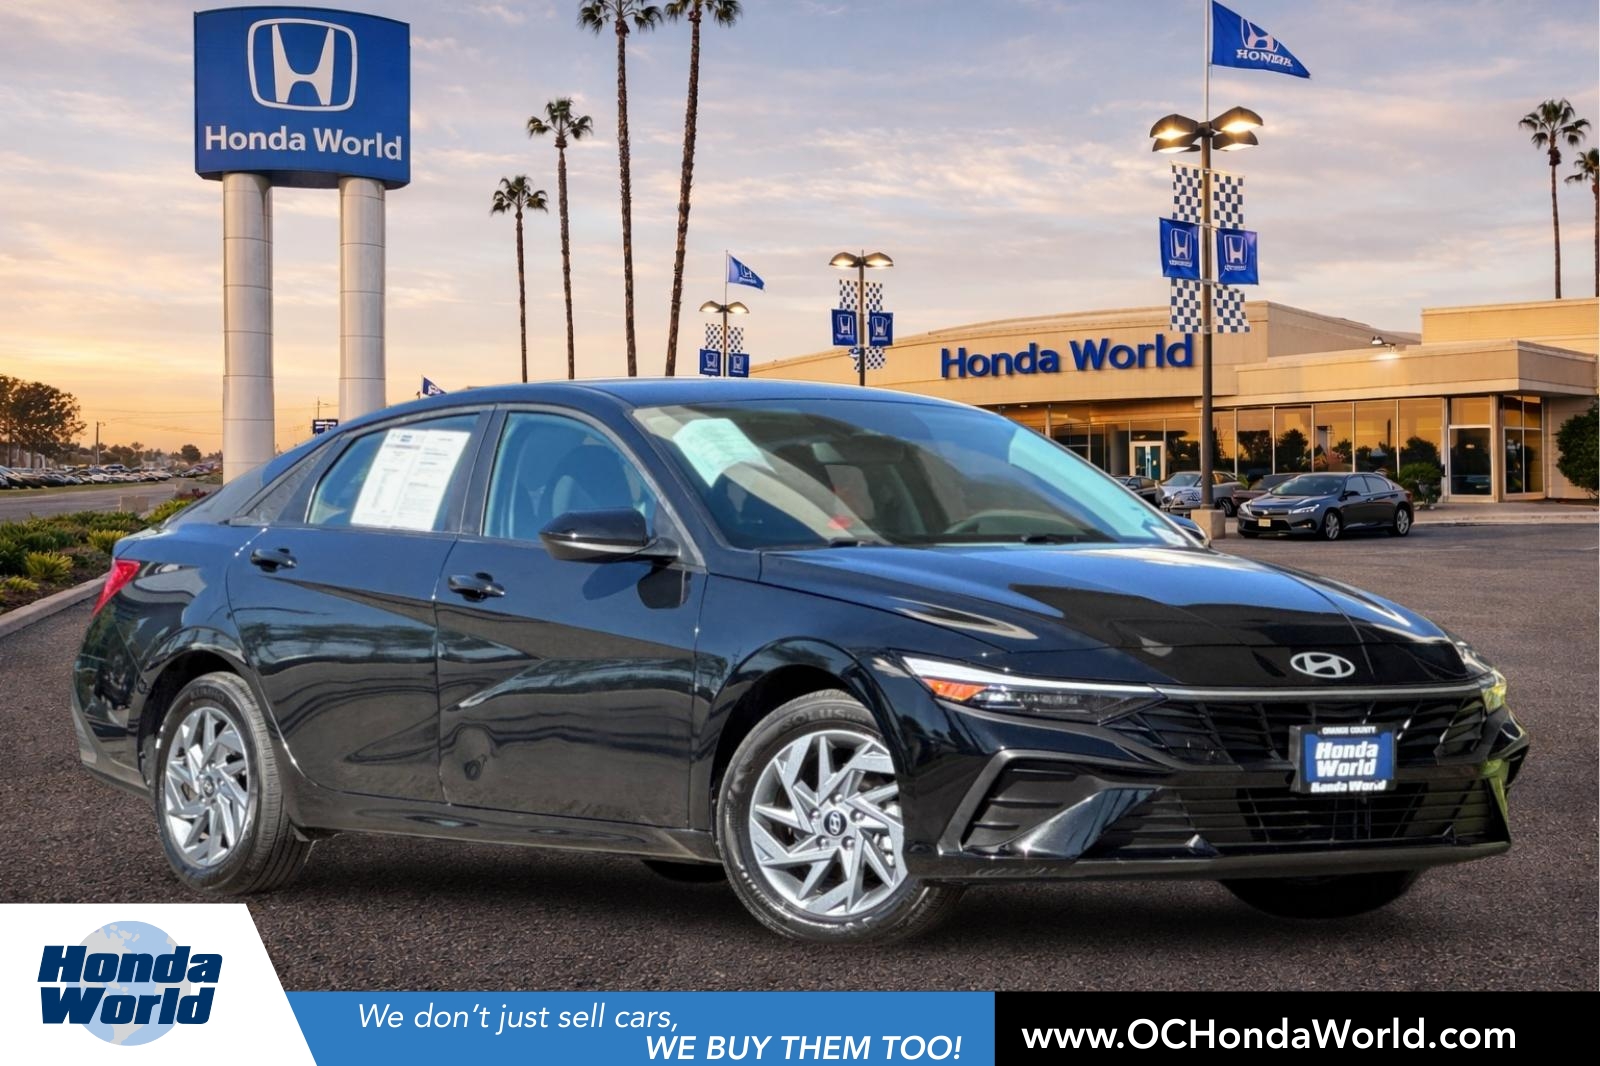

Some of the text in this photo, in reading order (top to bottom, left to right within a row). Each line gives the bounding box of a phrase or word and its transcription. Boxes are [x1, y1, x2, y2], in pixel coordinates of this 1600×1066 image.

[205, 125, 402, 161] Honda World
[941, 333, 1195, 378] Honda World
[1315, 741, 1379, 760] Honda
[1316, 759, 1377, 777] World
